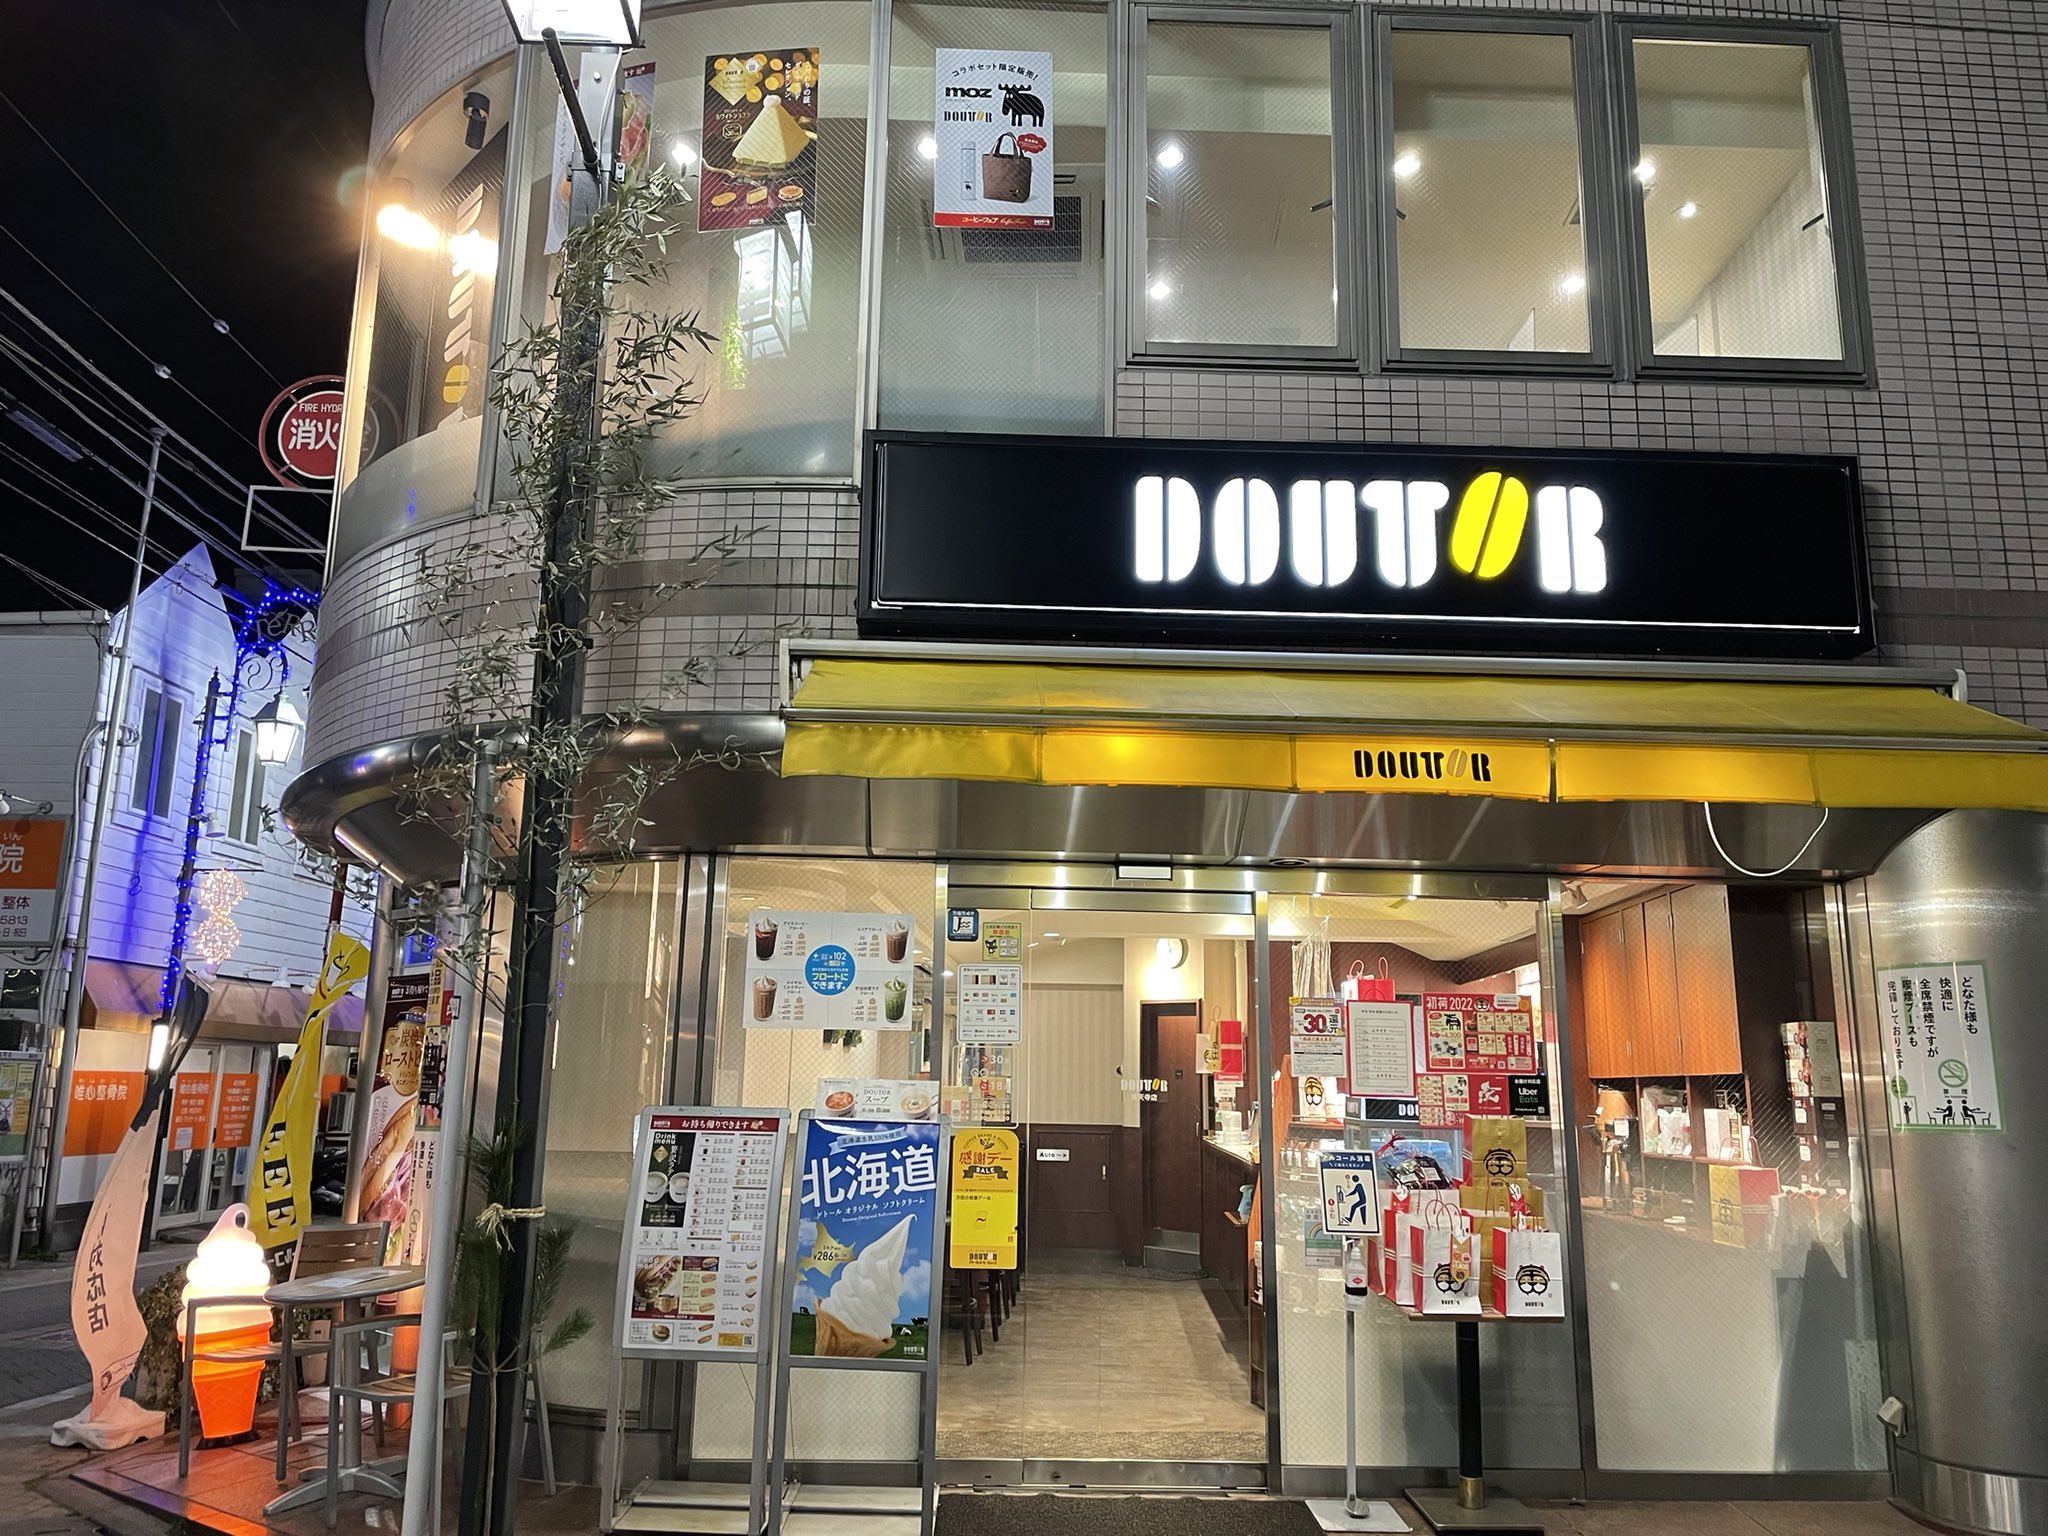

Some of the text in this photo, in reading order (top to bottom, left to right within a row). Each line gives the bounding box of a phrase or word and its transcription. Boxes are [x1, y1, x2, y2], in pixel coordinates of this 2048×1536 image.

[945, 87, 993, 98] moz
[944, 111, 993, 122] DOUTOR
[299, 403, 318, 413] FIRE
[287, 418, 340, 450] 消火
[1133, 471, 1607, 594] DOUTOR
[1353, 748, 1493, 783] DOUTOR
[1, 895, 31, 910] 整体
[812, 972, 849, 981] フロートに
[811, 981, 846, 990] できます。
[1939, 977, 1955, 1013] 快適に
[1448, 997, 1474, 1011] 2022
[1961, 976, 1979, 1036] どなた様も
[1901, 979, 1919, 1048] 喫煙ブースも
[1919, 978, 1940, 1059] 全席禁煙ですが
[863, 1088, 892, 1096] DOUTOR
[1518, 1087, 1538, 1096] Uber
[865, 1095, 889, 1103] スープ
[1519, 1095, 1539, 1104] Eats
[681, 1119, 750, 1130] お持ち帰りできます
[655, 1132, 677, 1140] Drink
[959, 1149, 1013, 1166] 感謝デー
[975, 1166, 996, 1174] SALE
[800, 1144, 937, 1208] 北海道
[844, 1202, 879, 1215] オリジナル
[883, 1196, 926, 1210] ソフトクリーム
[813, 1251, 834, 1261] ¥286
